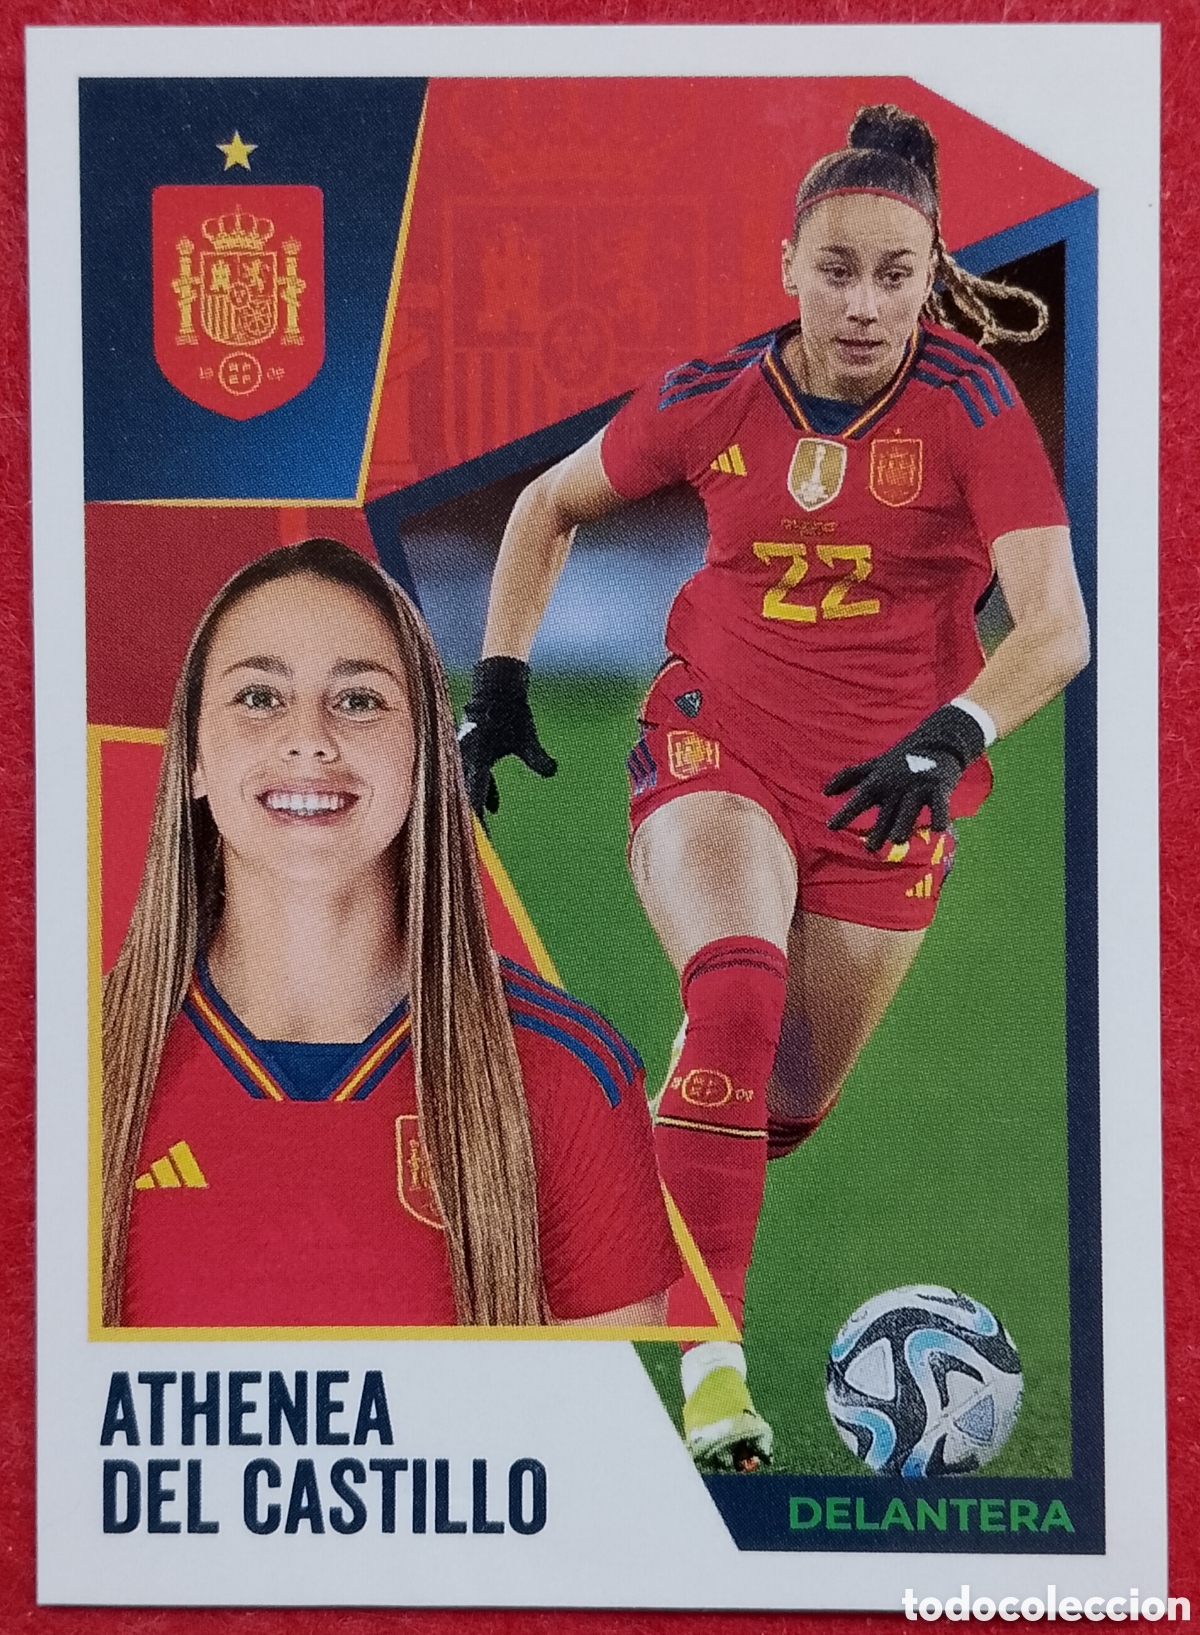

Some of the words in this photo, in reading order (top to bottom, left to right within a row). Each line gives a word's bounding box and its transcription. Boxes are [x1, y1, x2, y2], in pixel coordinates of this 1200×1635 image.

[752, 541, 881, 623] 22
[99, 1370, 395, 1446] ATHENEA
[102, 1458, 220, 1534] DEL
[243, 1457, 547, 1535] CASTILLO
[788, 1496, 1075, 1533] DELANTERA
